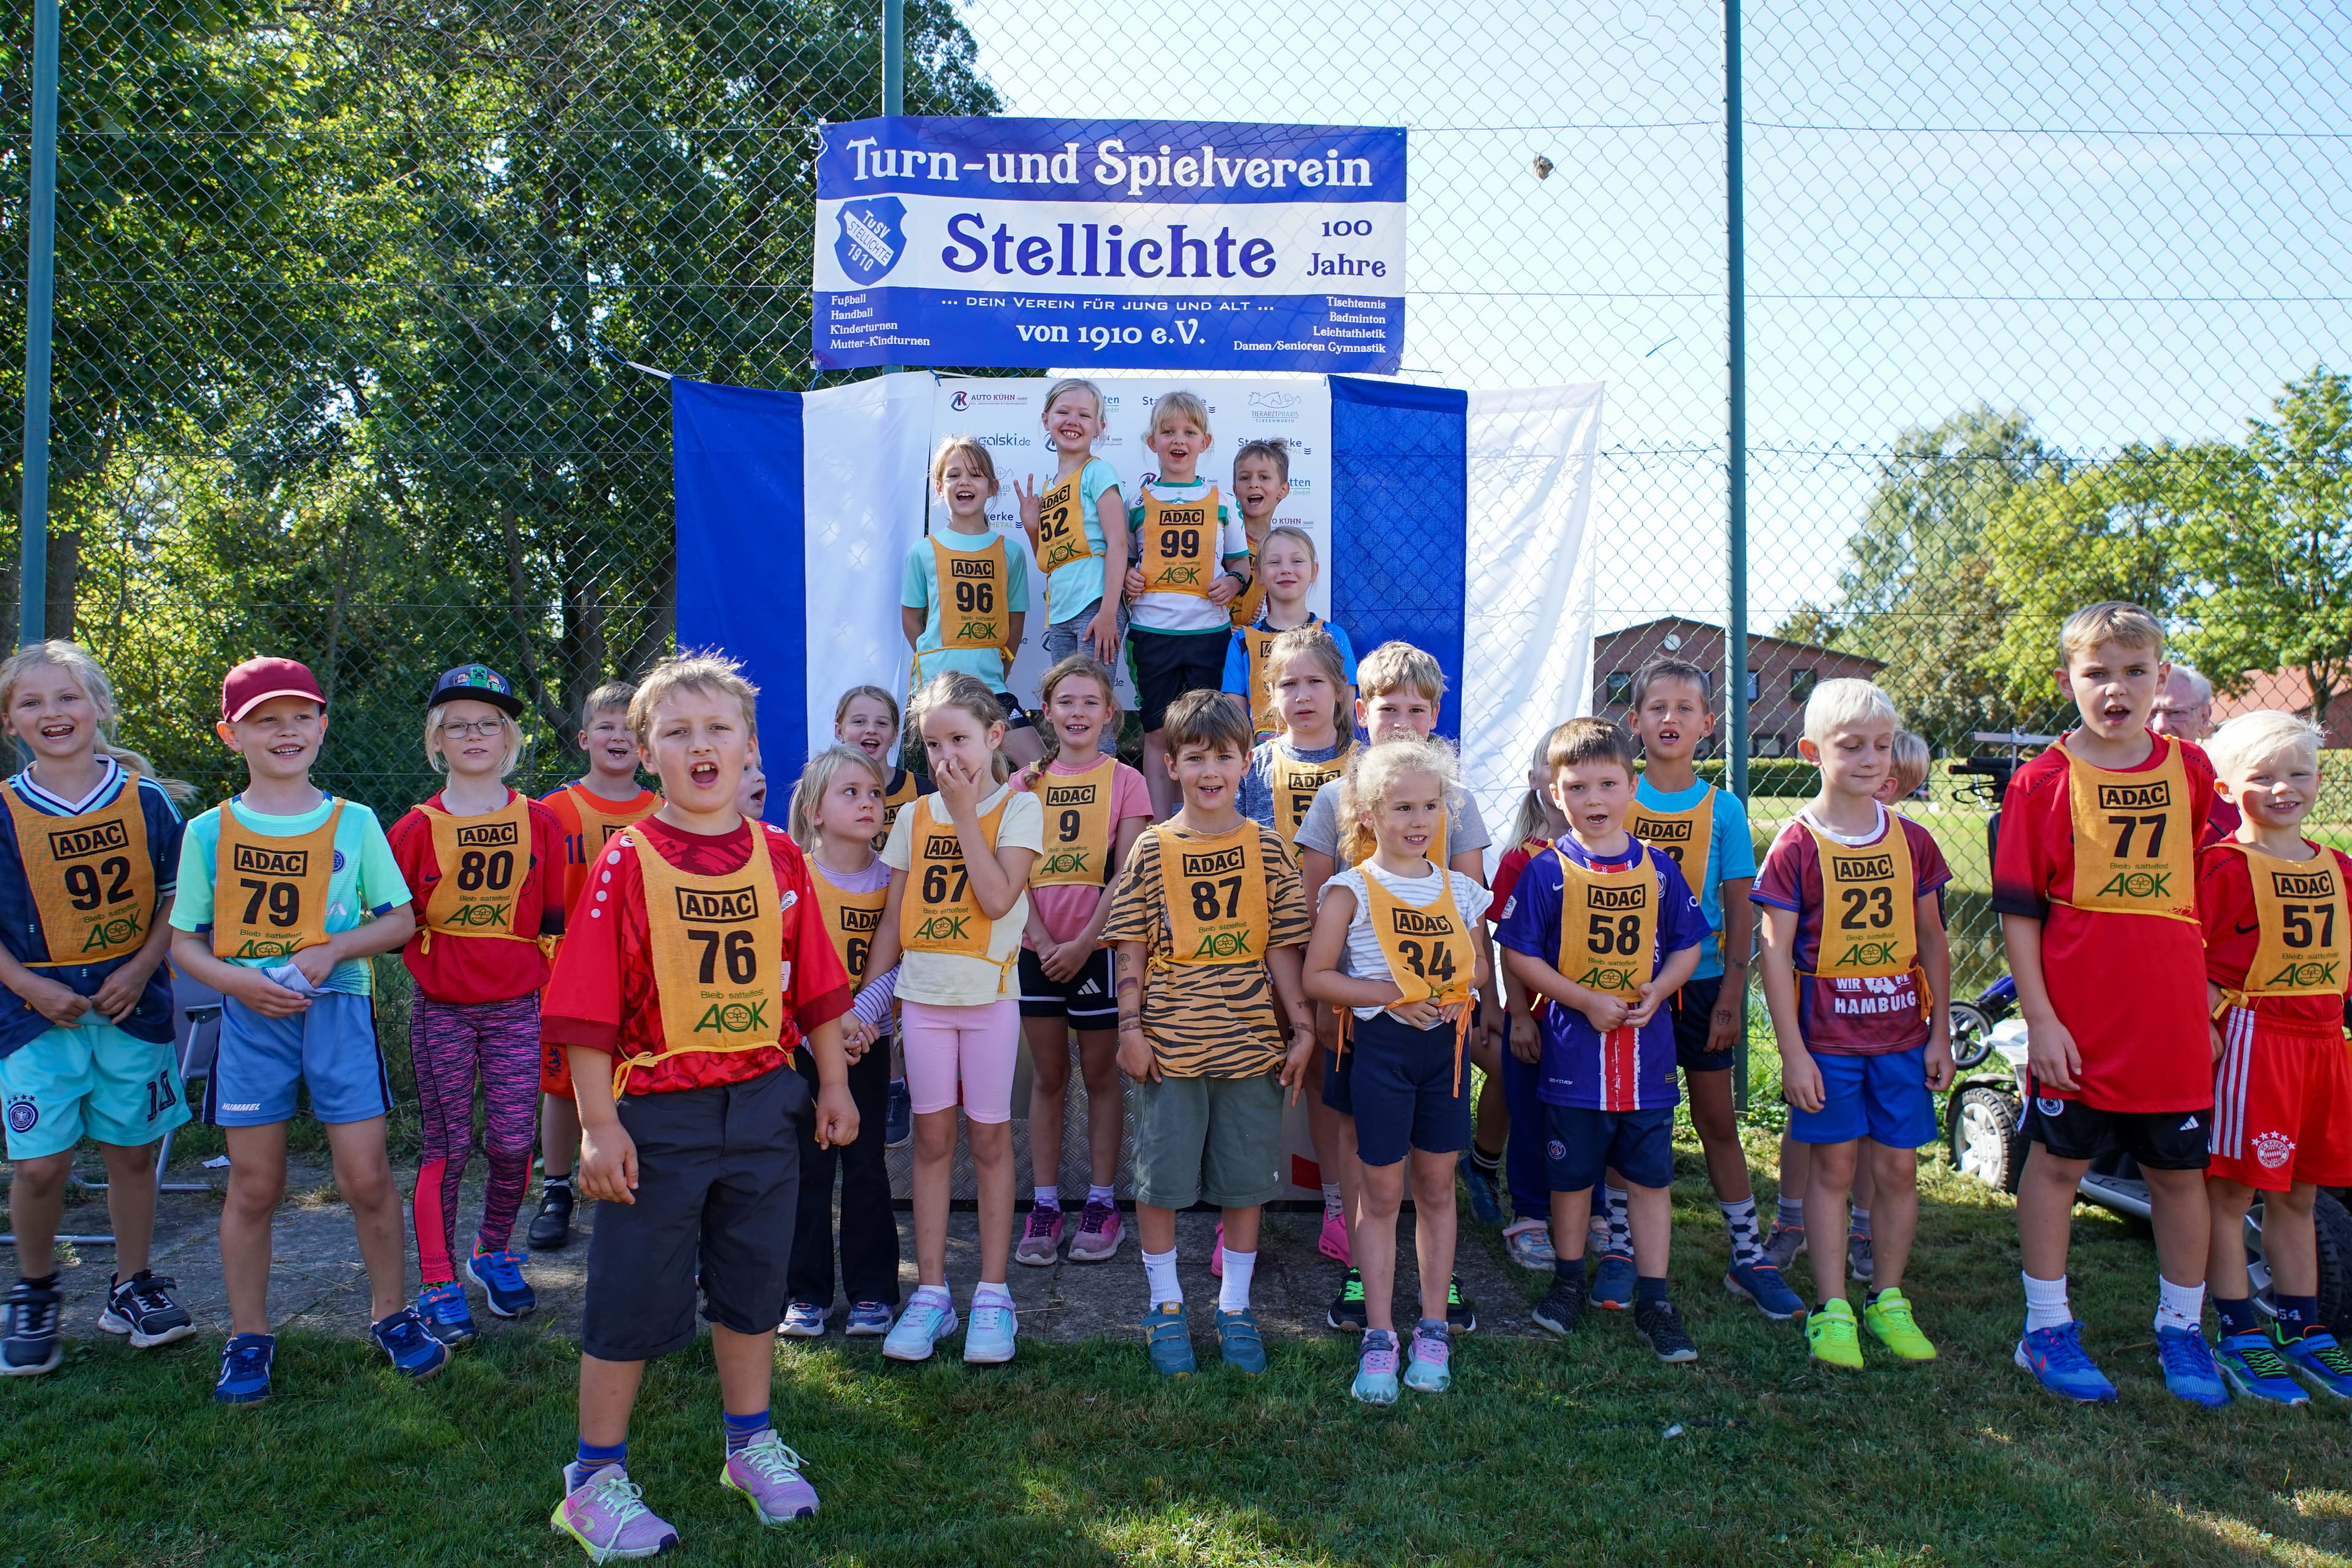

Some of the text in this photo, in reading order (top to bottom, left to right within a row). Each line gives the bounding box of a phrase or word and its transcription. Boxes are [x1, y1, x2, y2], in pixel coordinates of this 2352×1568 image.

[1094, 139, 1373, 195] Spielverein
[862, 209, 891, 239] TuSV
[1321, 220, 1373, 237] 100
[848, 221, 891, 262] STELLICHTE
[941, 213, 1276, 278] Stellichte
[848, 244, 875, 271] 1910
[1306, 253, 1386, 277] Jahre
[831, 294, 866, 307] Fußball
[967, 297, 1005, 307] DEIN
[1084, 298, 1115, 310] FÜR
[1123, 301, 1168, 311] JUNG
[1176, 302, 1212, 311] UND
[1219, 302, 1250, 311] ALT
[1326, 296, 1386, 309] Tischtennis
[831, 308, 873, 320] Handball
[1329, 312, 1386, 325] Badminton
[830, 321, 898, 335] Kinderturnen
[1016, 318, 1205, 351] von 1910 e.V.
[1313, 326, 1386, 339] Leichtathletik
[829, 336, 930, 349] Mutter-Kindturnen
[1234, 341, 1386, 354] Damen/Senioren Gymnastik
[1041, 489, 1067, 509] ADAC
[1040, 507, 1069, 543] 52
[1164, 511, 1200, 523] ADAC
[1047, 538, 1082, 568] AOK
[1161, 529, 1199, 558] 99
[956, 562, 991, 575] ADAC
[1154, 567, 1201, 585] AOK
[956, 581, 993, 613] 96
[956, 622, 997, 639] AOK
[1050, 788, 1091, 802] ADAC
[2106, 786, 2164, 805] ADAC
[464, 827, 513, 843] ADAC
[1060, 810, 1080, 842] 9
[1638, 823, 1687, 838] ADAC
[2108, 813, 2166, 858] 77
[60, 826, 121, 854] ADAC
[929, 840, 962, 855] ADA
[240, 850, 300, 872] ADAC
[458, 850, 513, 891] 80
[1039, 853, 1090, 875] AOK
[1189, 851, 1239, 873] ADAC
[1840, 859, 1889, 877] ADAC
[64, 856, 134, 910] 92
[922, 864, 968, 903] 67
[2096, 872, 2172, 898] AOK
[2281, 875, 2330, 894] ADAC
[240, 878, 300, 927] 79
[686, 894, 752, 917] ADAC
[1191, 876, 1242, 921] 87
[1593, 889, 1642, 907] ADAC
[1841, 886, 1893, 929] 23
[83, 913, 105, 923] Bleib
[443, 903, 511, 926] AOK
[846, 911, 880, 928] ADA
[1400, 913, 1447, 931] ADAC
[2283, 903, 2334, 948] 57
[81, 908, 143, 952] AOK
[913, 916, 971, 940] AOK
[1588, 913, 1640, 956] 58
[235, 938, 304, 957] AOK
[1191, 929, 1251, 959] AOK
[1834, 941, 1899, 967] AOK
[687, 929, 756, 984] 76
[847, 938, 872, 976] 6
[1398, 940, 1456, 982] 34
[1575, 967, 1639, 990] AOK
[1836, 978, 1861, 989] WIR
[2265, 961, 2341, 987] AOK
[1834, 990, 1916, 1014] HAMBURG
[693, 998, 769, 1033] AOK
[221, 1102, 261, 1112] HUMMEL
[2278, 1309, 2301, 1321] 54
